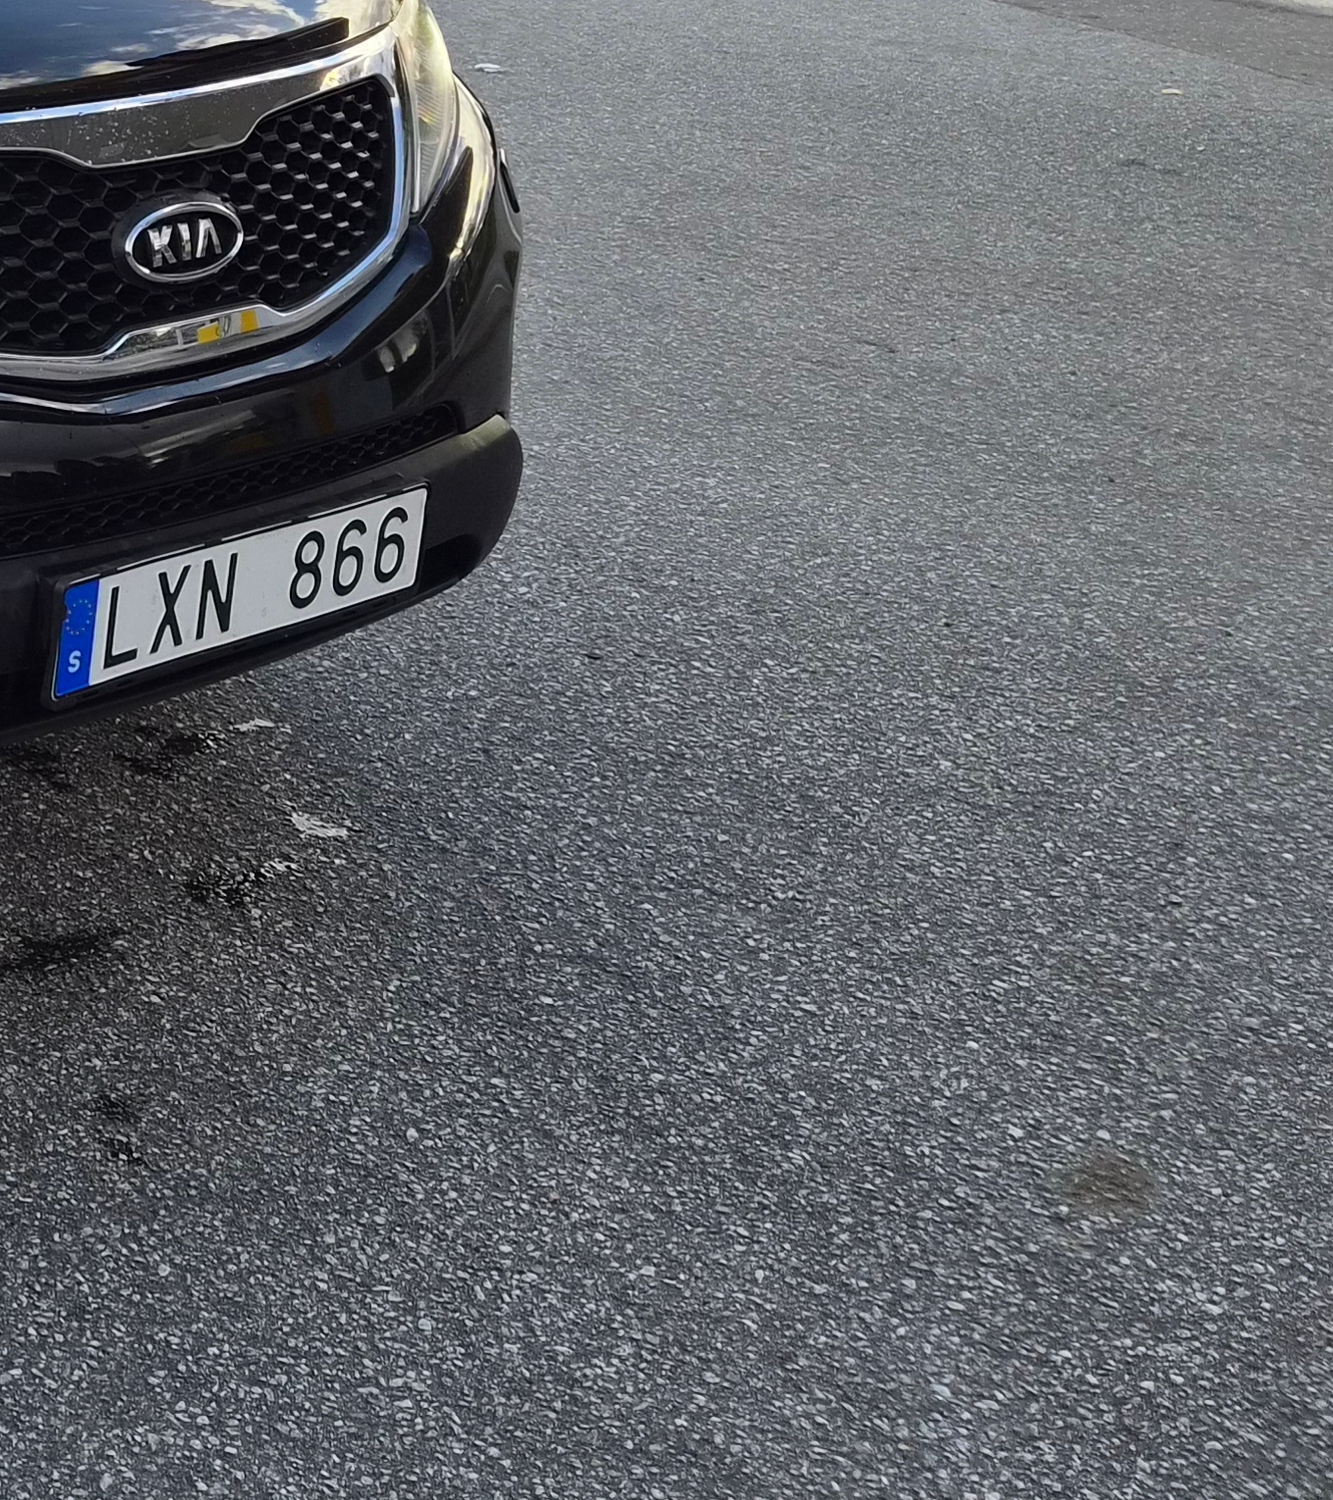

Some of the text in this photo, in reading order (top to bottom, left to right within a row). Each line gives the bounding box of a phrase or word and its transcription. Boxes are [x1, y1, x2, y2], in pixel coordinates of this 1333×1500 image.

[148, 218, 222, 268] KIA
[103, 506, 409, 669] LXN 866
[67, 649, 82, 674] S
